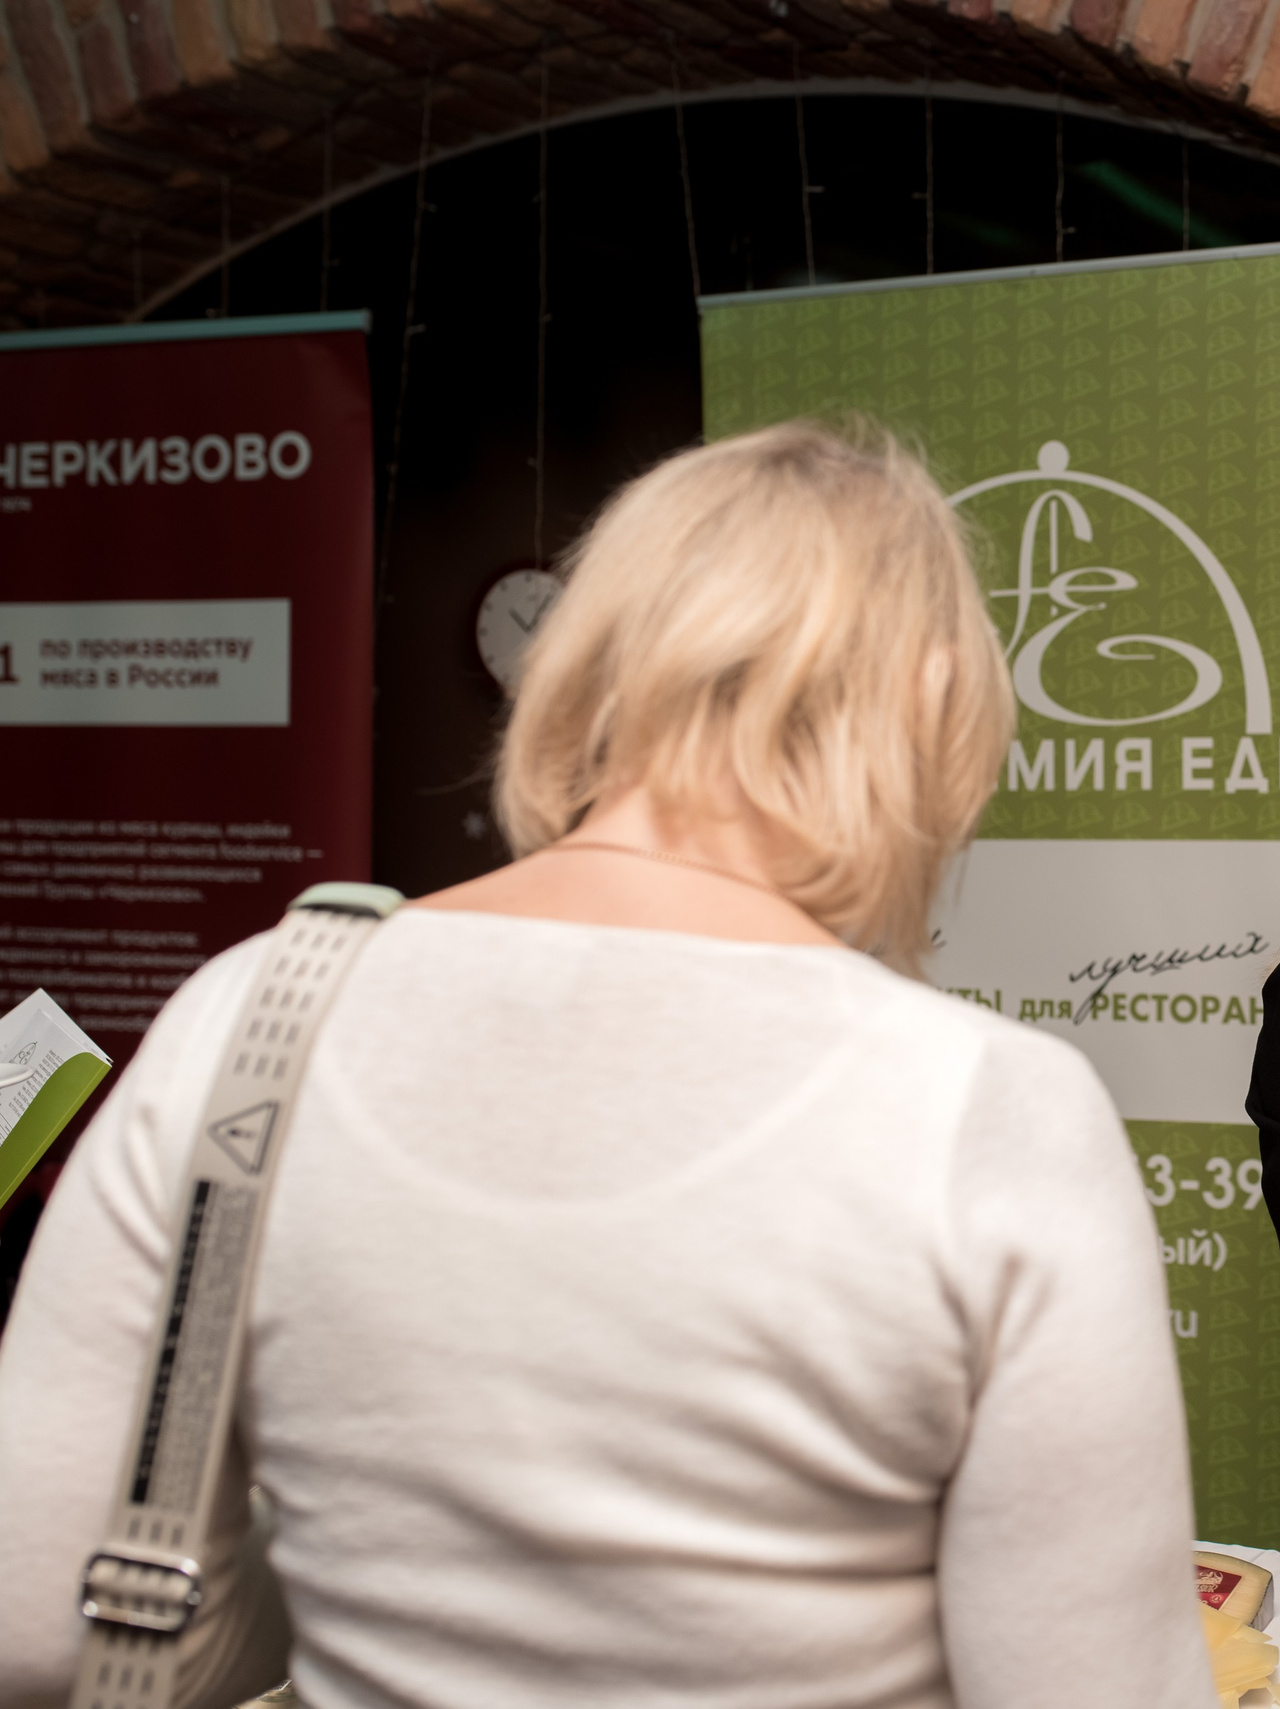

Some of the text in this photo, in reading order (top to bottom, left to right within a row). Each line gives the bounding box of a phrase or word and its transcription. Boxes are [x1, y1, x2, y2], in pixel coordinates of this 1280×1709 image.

[40, 639, 253, 661] по производству
[41, 664, 219, 687] мяса в России
[1007, 738, 1153, 792] МИЯ
[1018, 998, 1073, 1023] для
[1091, 992, 1264, 1025] РЕСТОРАН
[1145, 1154, 1264, 1210] 3-39
